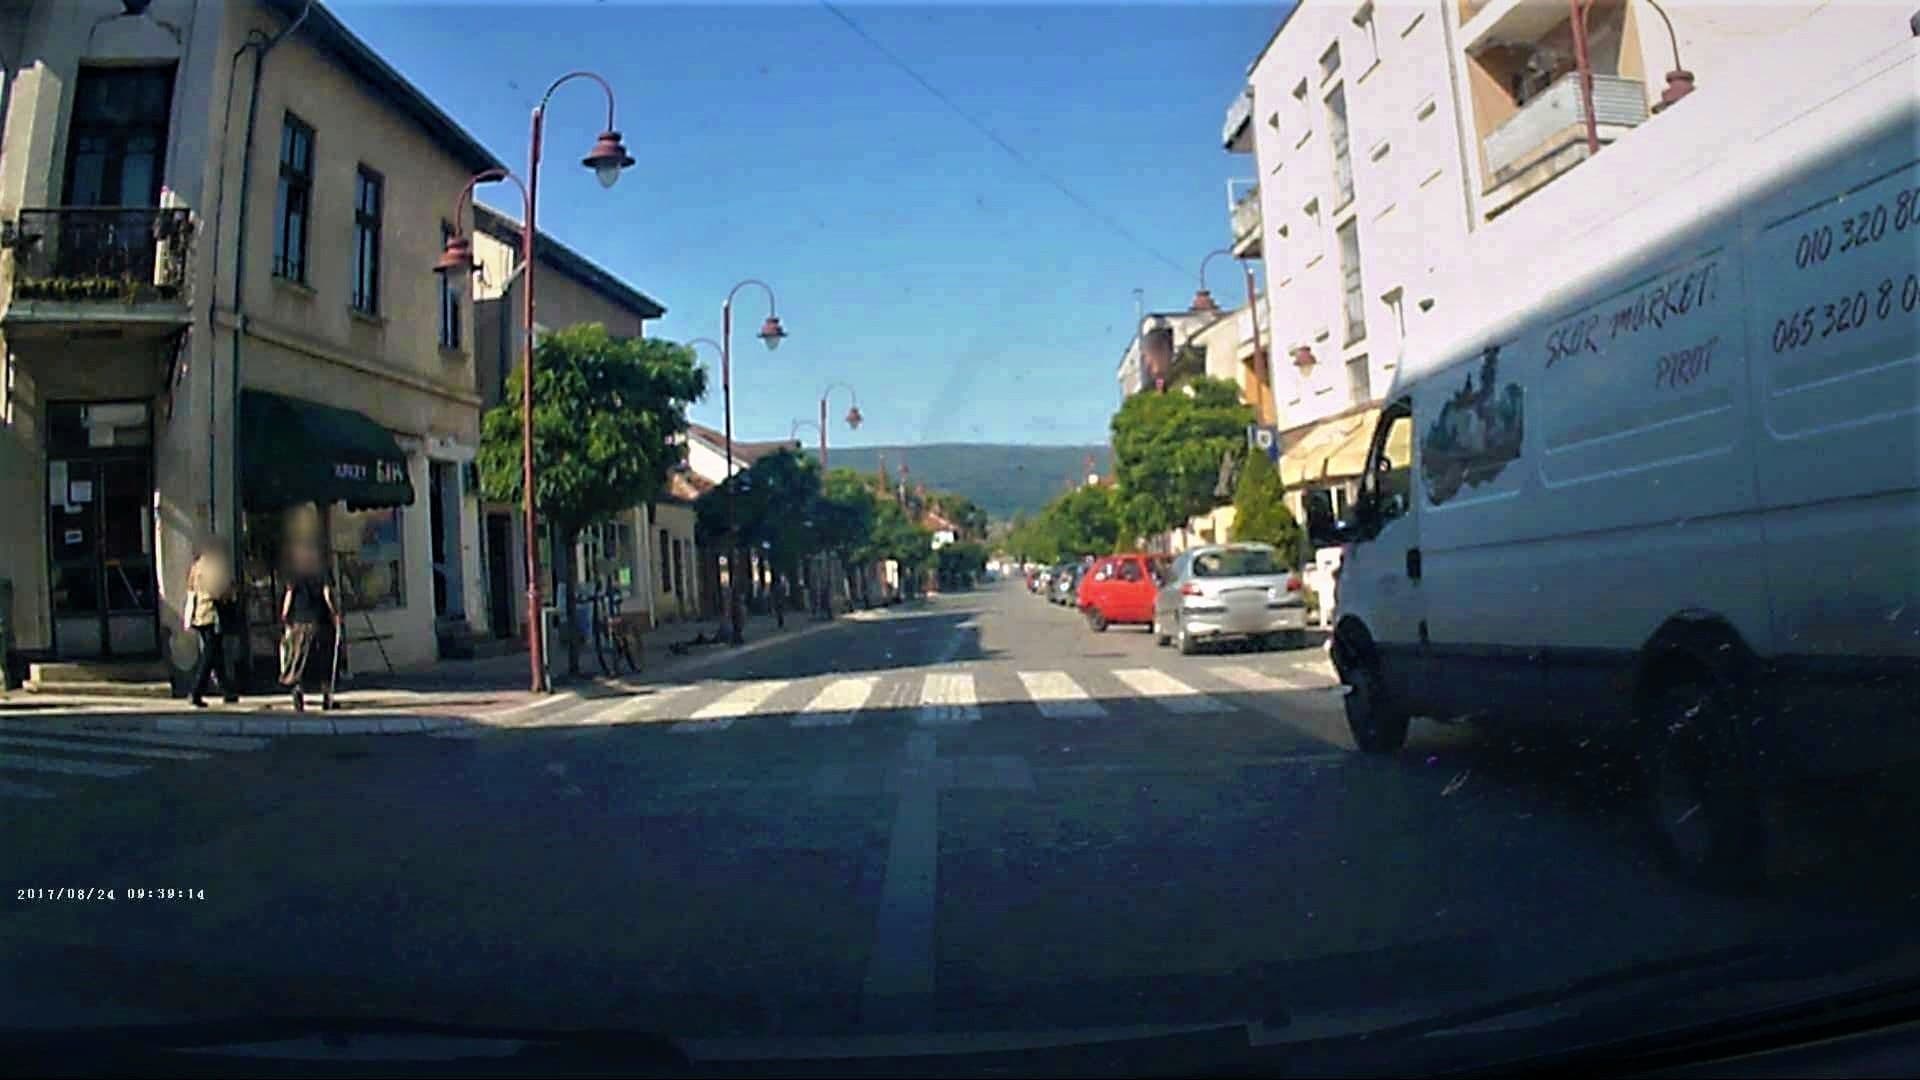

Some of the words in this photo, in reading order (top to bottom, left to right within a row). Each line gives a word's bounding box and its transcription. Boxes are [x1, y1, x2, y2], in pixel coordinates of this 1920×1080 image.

[1796, 225, 1833, 270] 010
[1839, 203, 1887, 253] 320
[1773, 305, 1816, 353] 065
[1822, 290, 1868, 338] 320
[1902, 273, 1920, 313] 0
